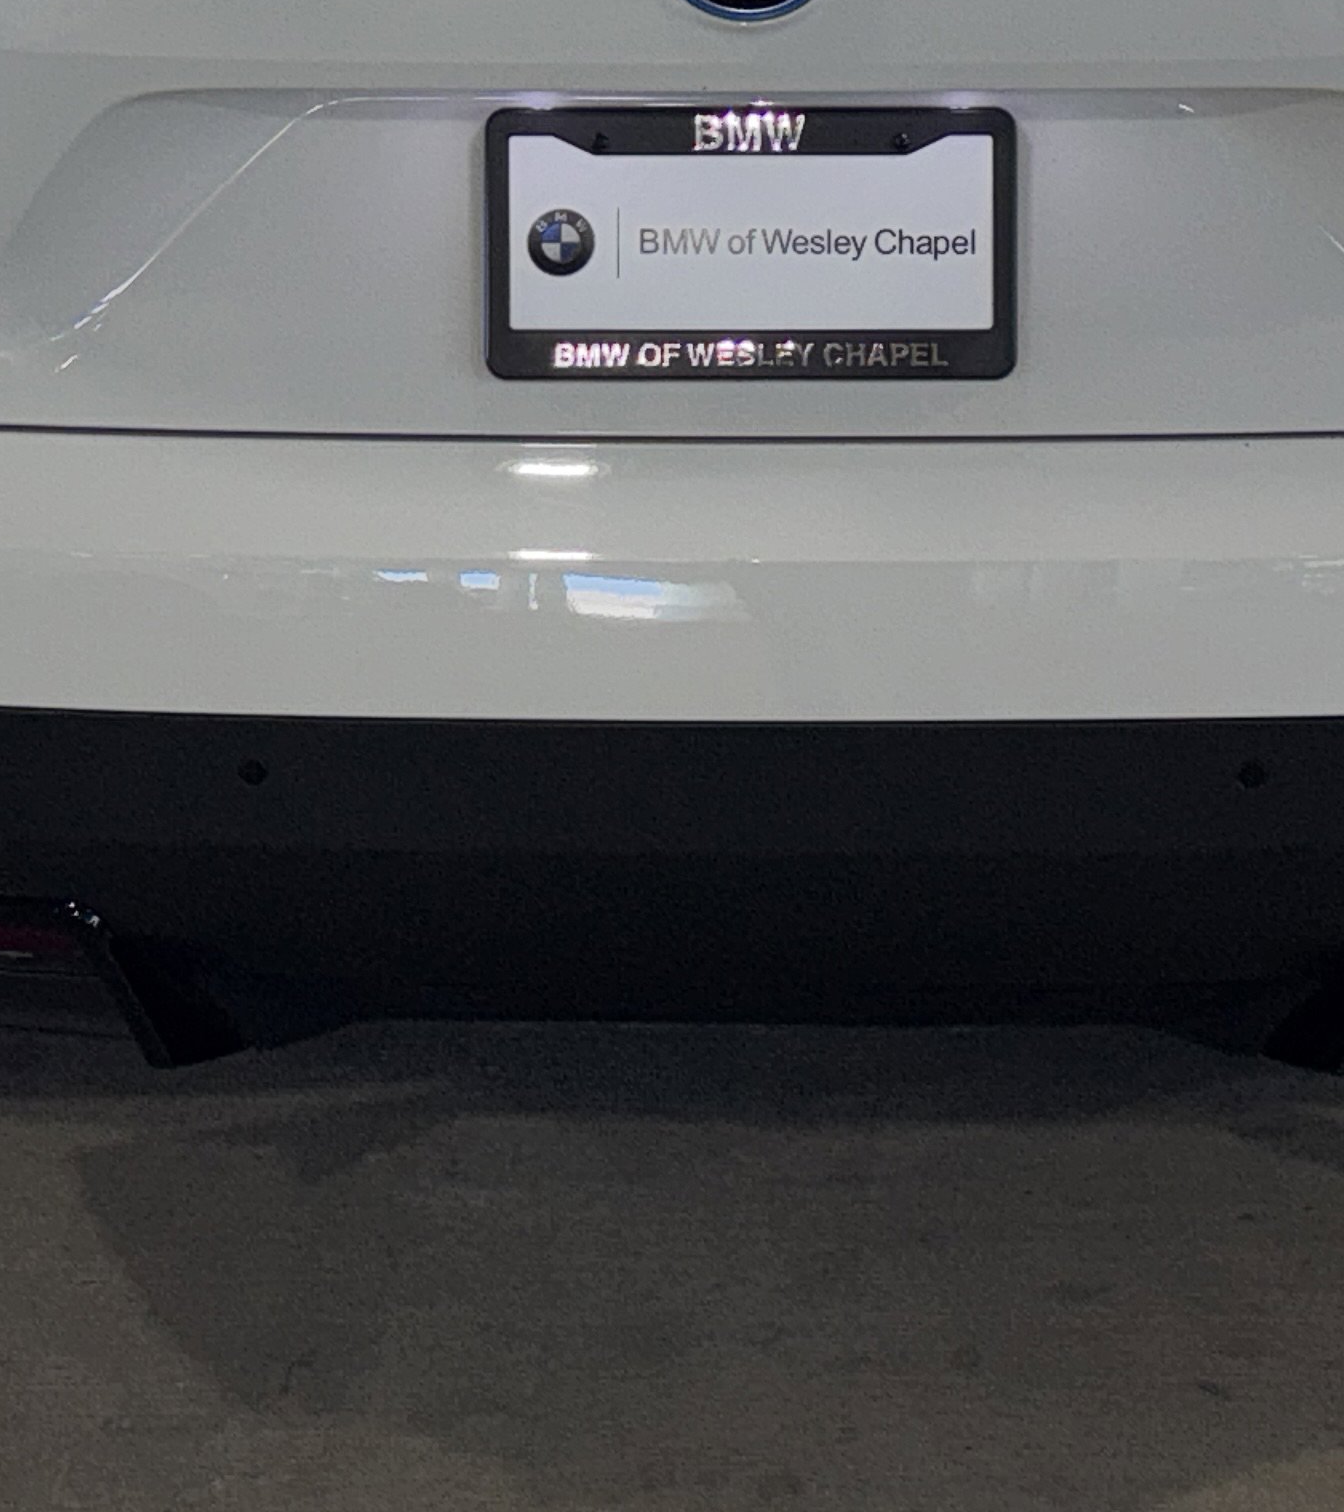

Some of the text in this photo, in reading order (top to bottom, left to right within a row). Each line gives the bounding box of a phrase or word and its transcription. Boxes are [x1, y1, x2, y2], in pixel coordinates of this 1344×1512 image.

[693, 110, 805, 152] BMW
[639, 227, 976, 261] BMW of Wesley Chapel
[554, 340, 950, 368] BMW OF WESLEY CHAPEL
